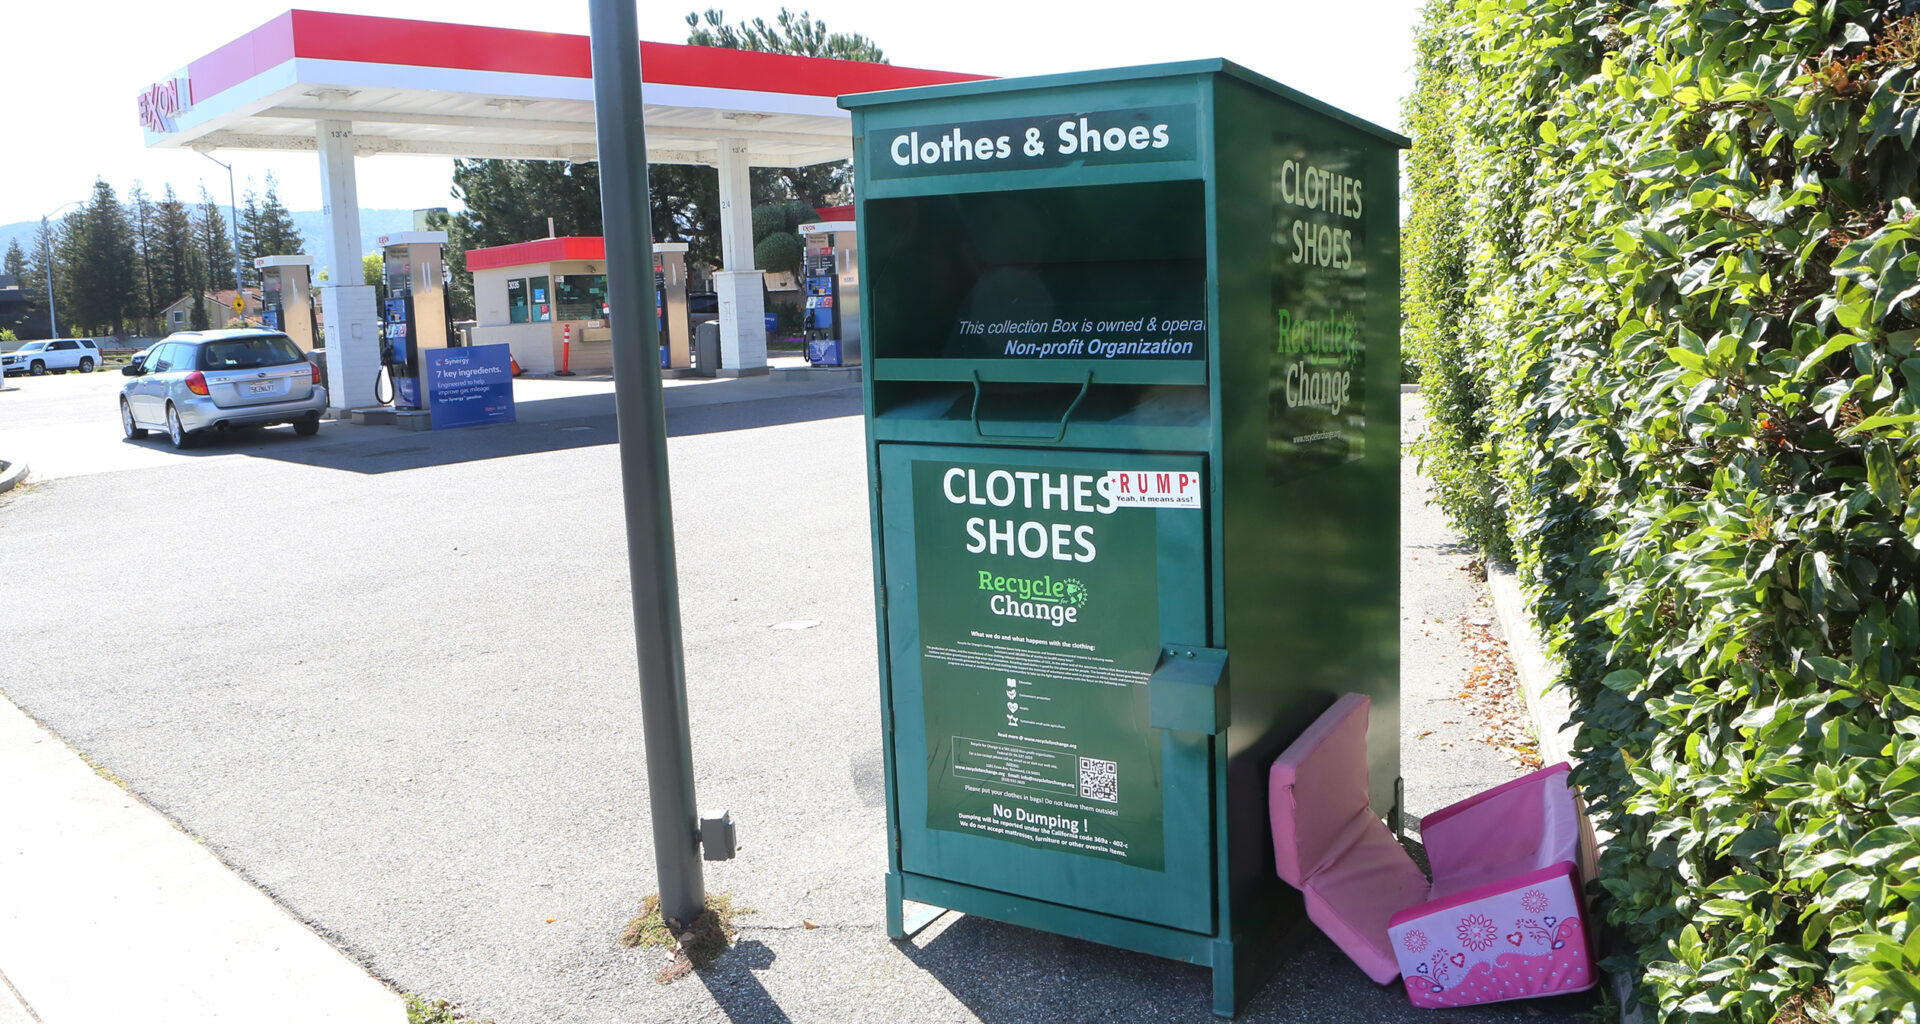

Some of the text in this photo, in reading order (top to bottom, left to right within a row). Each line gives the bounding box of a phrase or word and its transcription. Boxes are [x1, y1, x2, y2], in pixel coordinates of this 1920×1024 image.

[137, 77, 180, 132] EXXON
[891, 118, 1170, 166] Clothes & Shoes
[1280, 159, 1362, 220] CLOTHES
[1292, 219, 1352, 270] SHOES
[508, 281, 520, 290] 3035
[960, 320, 984, 335] This
[988, 319, 1048, 334] collection
[1052, 318, 1078, 333] Box
[1081, 318, 1092, 332] is
[1096, 318, 1144, 332] owned
[1146, 317, 1157, 331] &
[1278, 309, 1343, 365] Recycle
[1004, 338, 1193, 358] Non-profit Organization
[444, 370, 457, 378] key
[458, 366, 502, 377] ingredients.
[1286, 360, 1351, 416] Change
[943, 468, 1118, 514] CLOTHES
[1120, 473, 1189, 494] RUMP
[966, 517, 1096, 563] SHOES
[978, 570, 1064, 599] Recycle
[990, 594, 1077, 626] Change
[958, 813, 981, 822] Dumping
[1051, 830, 1078, 838] California
[993, 804, 1087, 833] No Dumping !
[1005, 830, 1034, 841] mattresses,
[1035, 836, 1060, 844] furniture
[1109, 848, 1127, 856] items.
